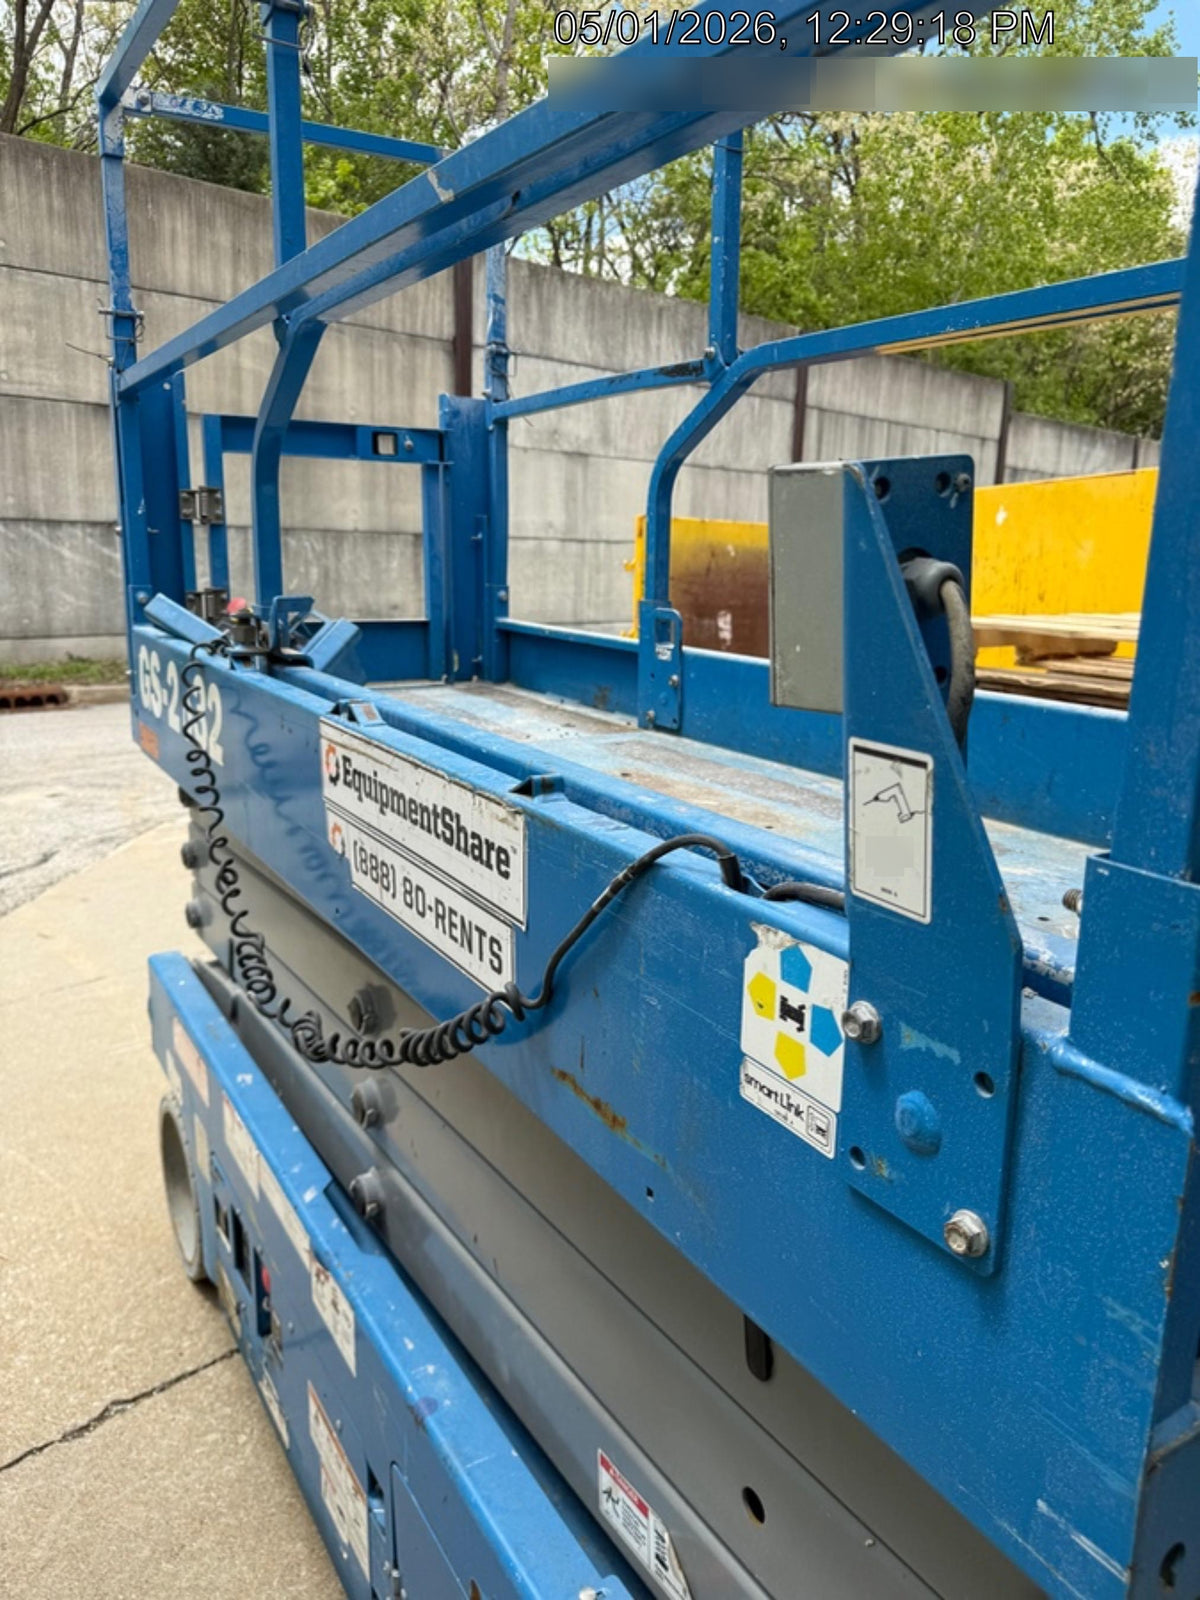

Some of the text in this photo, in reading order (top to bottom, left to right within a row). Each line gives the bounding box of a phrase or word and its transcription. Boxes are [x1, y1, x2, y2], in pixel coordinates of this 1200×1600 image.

[342, 755, 512, 880] EquipmentShare
[353, 839, 502, 975] (888) 80-RENTS
